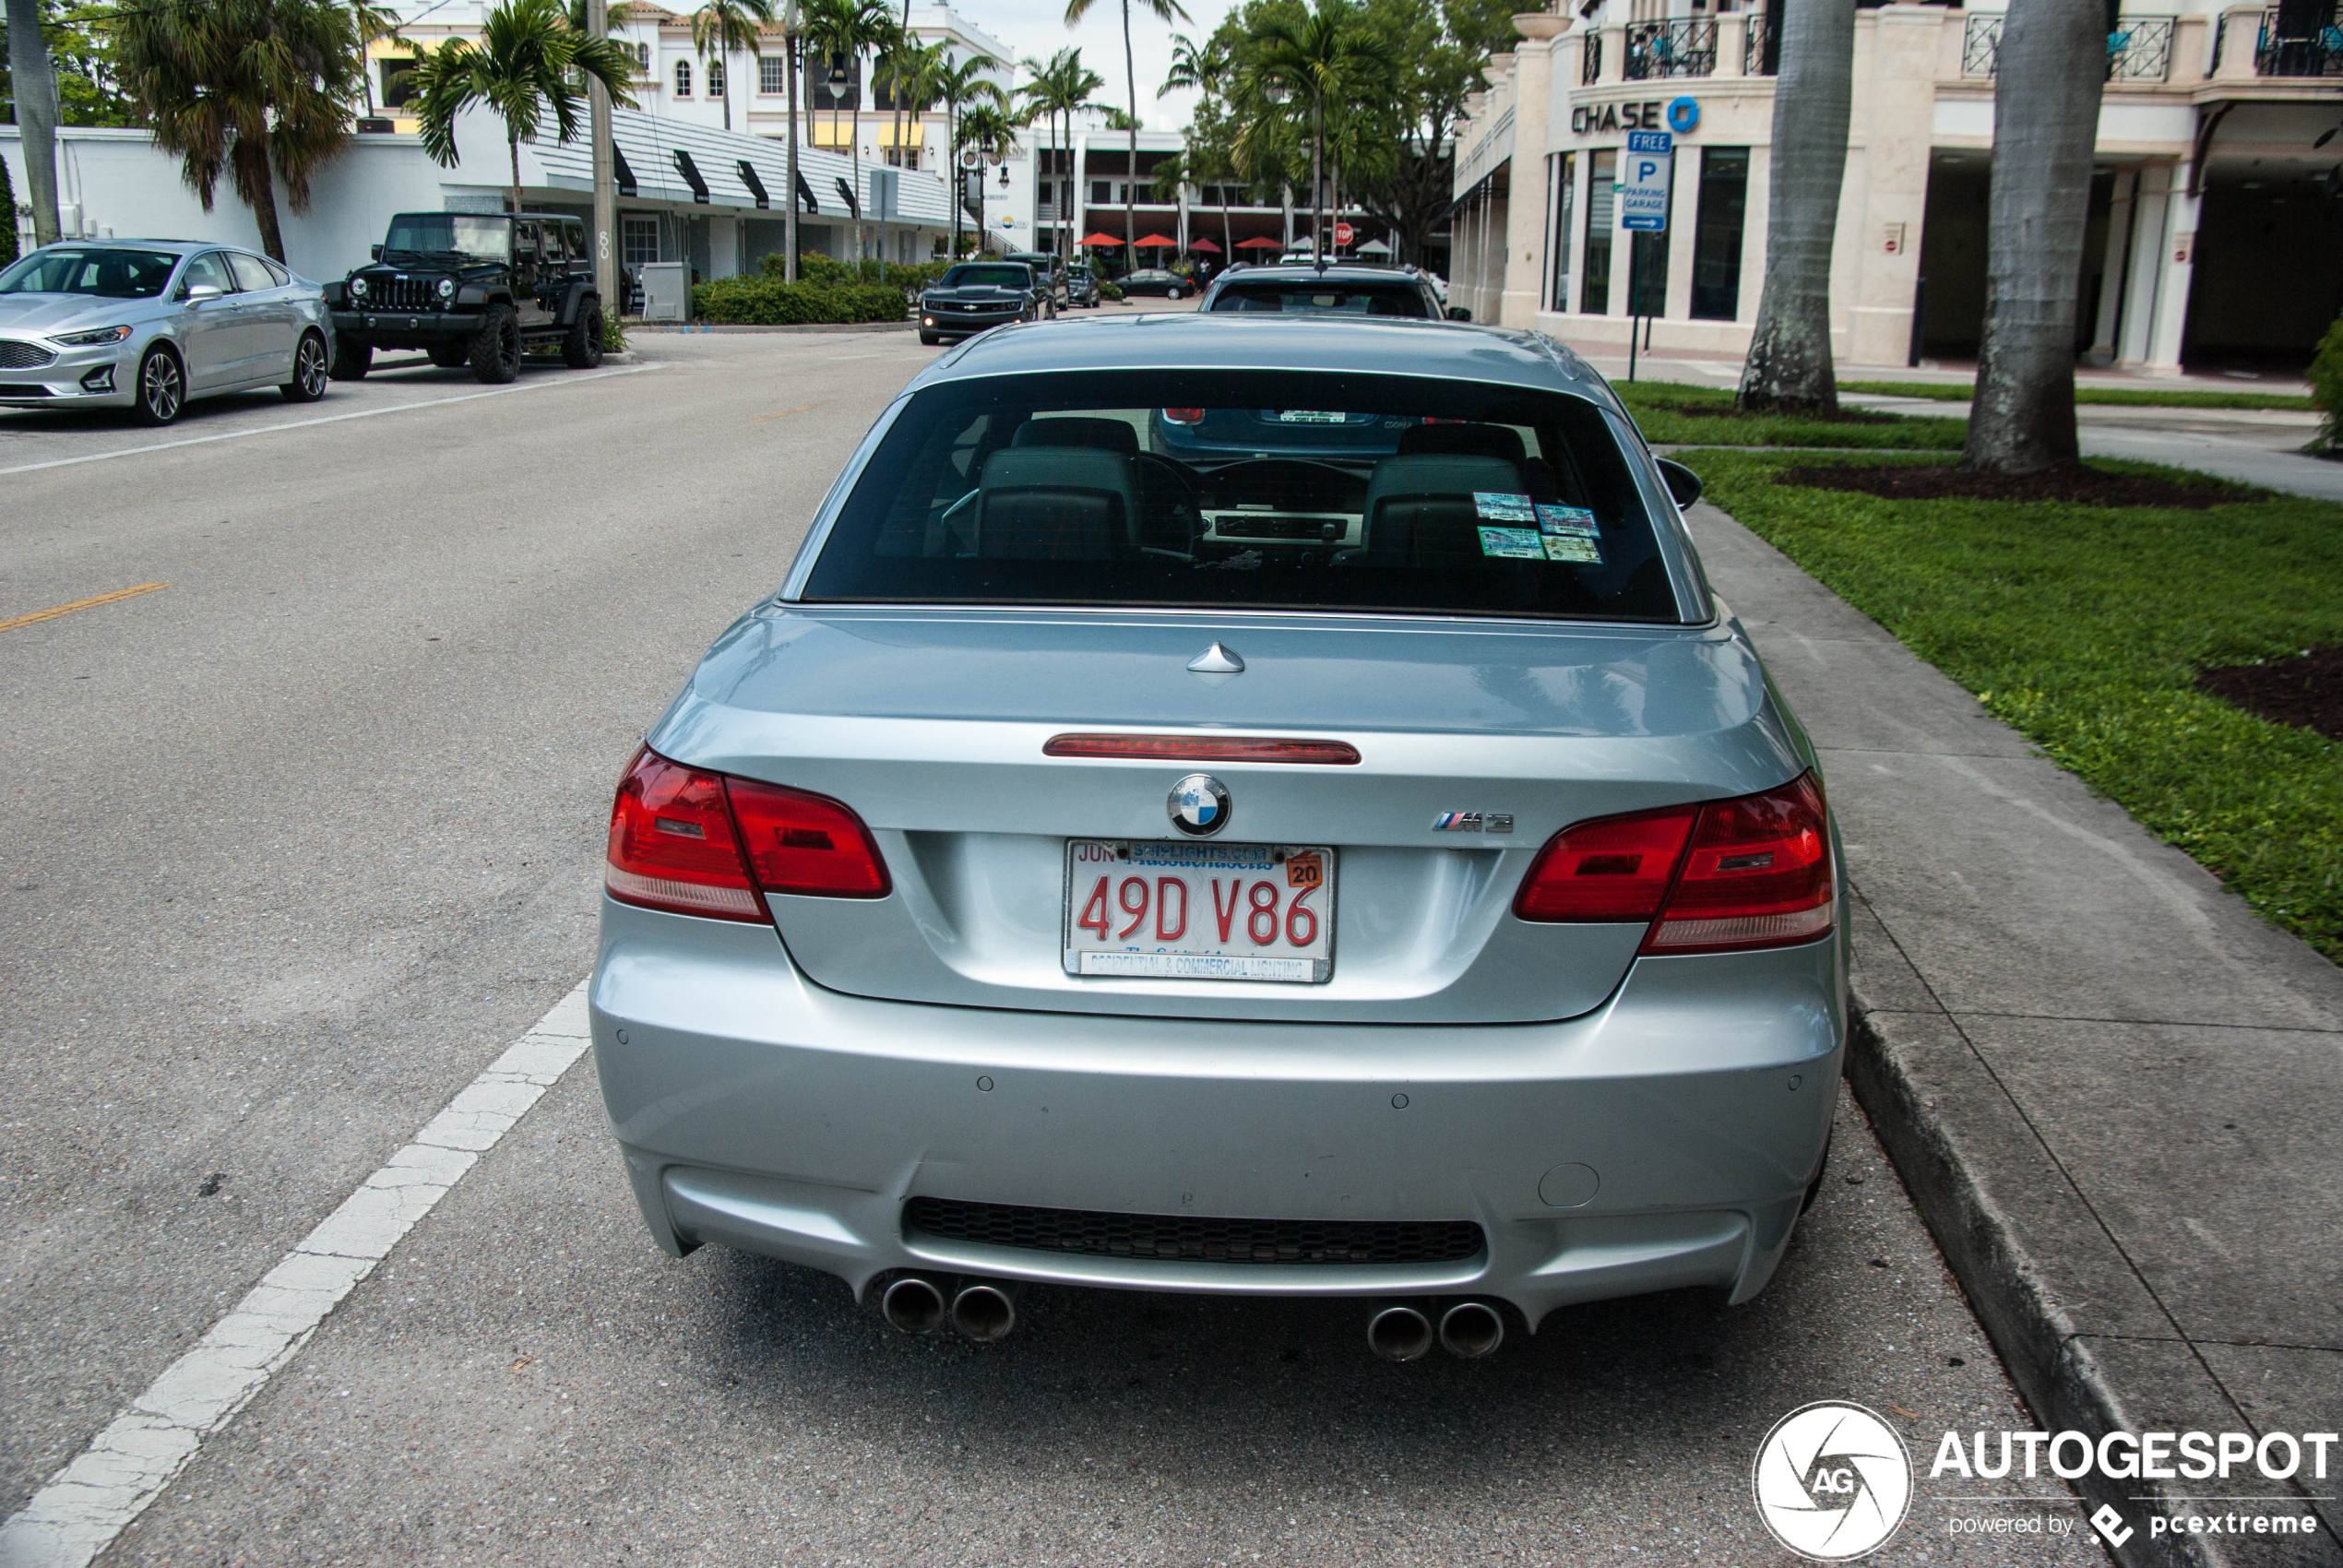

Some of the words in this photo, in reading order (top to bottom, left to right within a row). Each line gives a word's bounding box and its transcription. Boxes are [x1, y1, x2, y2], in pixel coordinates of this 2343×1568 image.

[1572, 101, 1662, 133] CHASE
[1633, 135, 1668, 150] FREE
[1638, 161, 1657, 183] P
[1625, 187, 1666, 198] PARKING
[1625, 198, 1664, 210] GARAGE
[1337, 230, 1352, 240] TOP
[1384, 421, 1413, 429] COOPER
[1432, 812, 1514, 833] M3
[1077, 844, 1115, 862] JUN
[1292, 865, 1317, 883] 20
[1077, 874, 1188, 941] 49D
[1210, 878, 1318, 947] V86
[1176, 956, 1248, 976] COMMERCIAL
